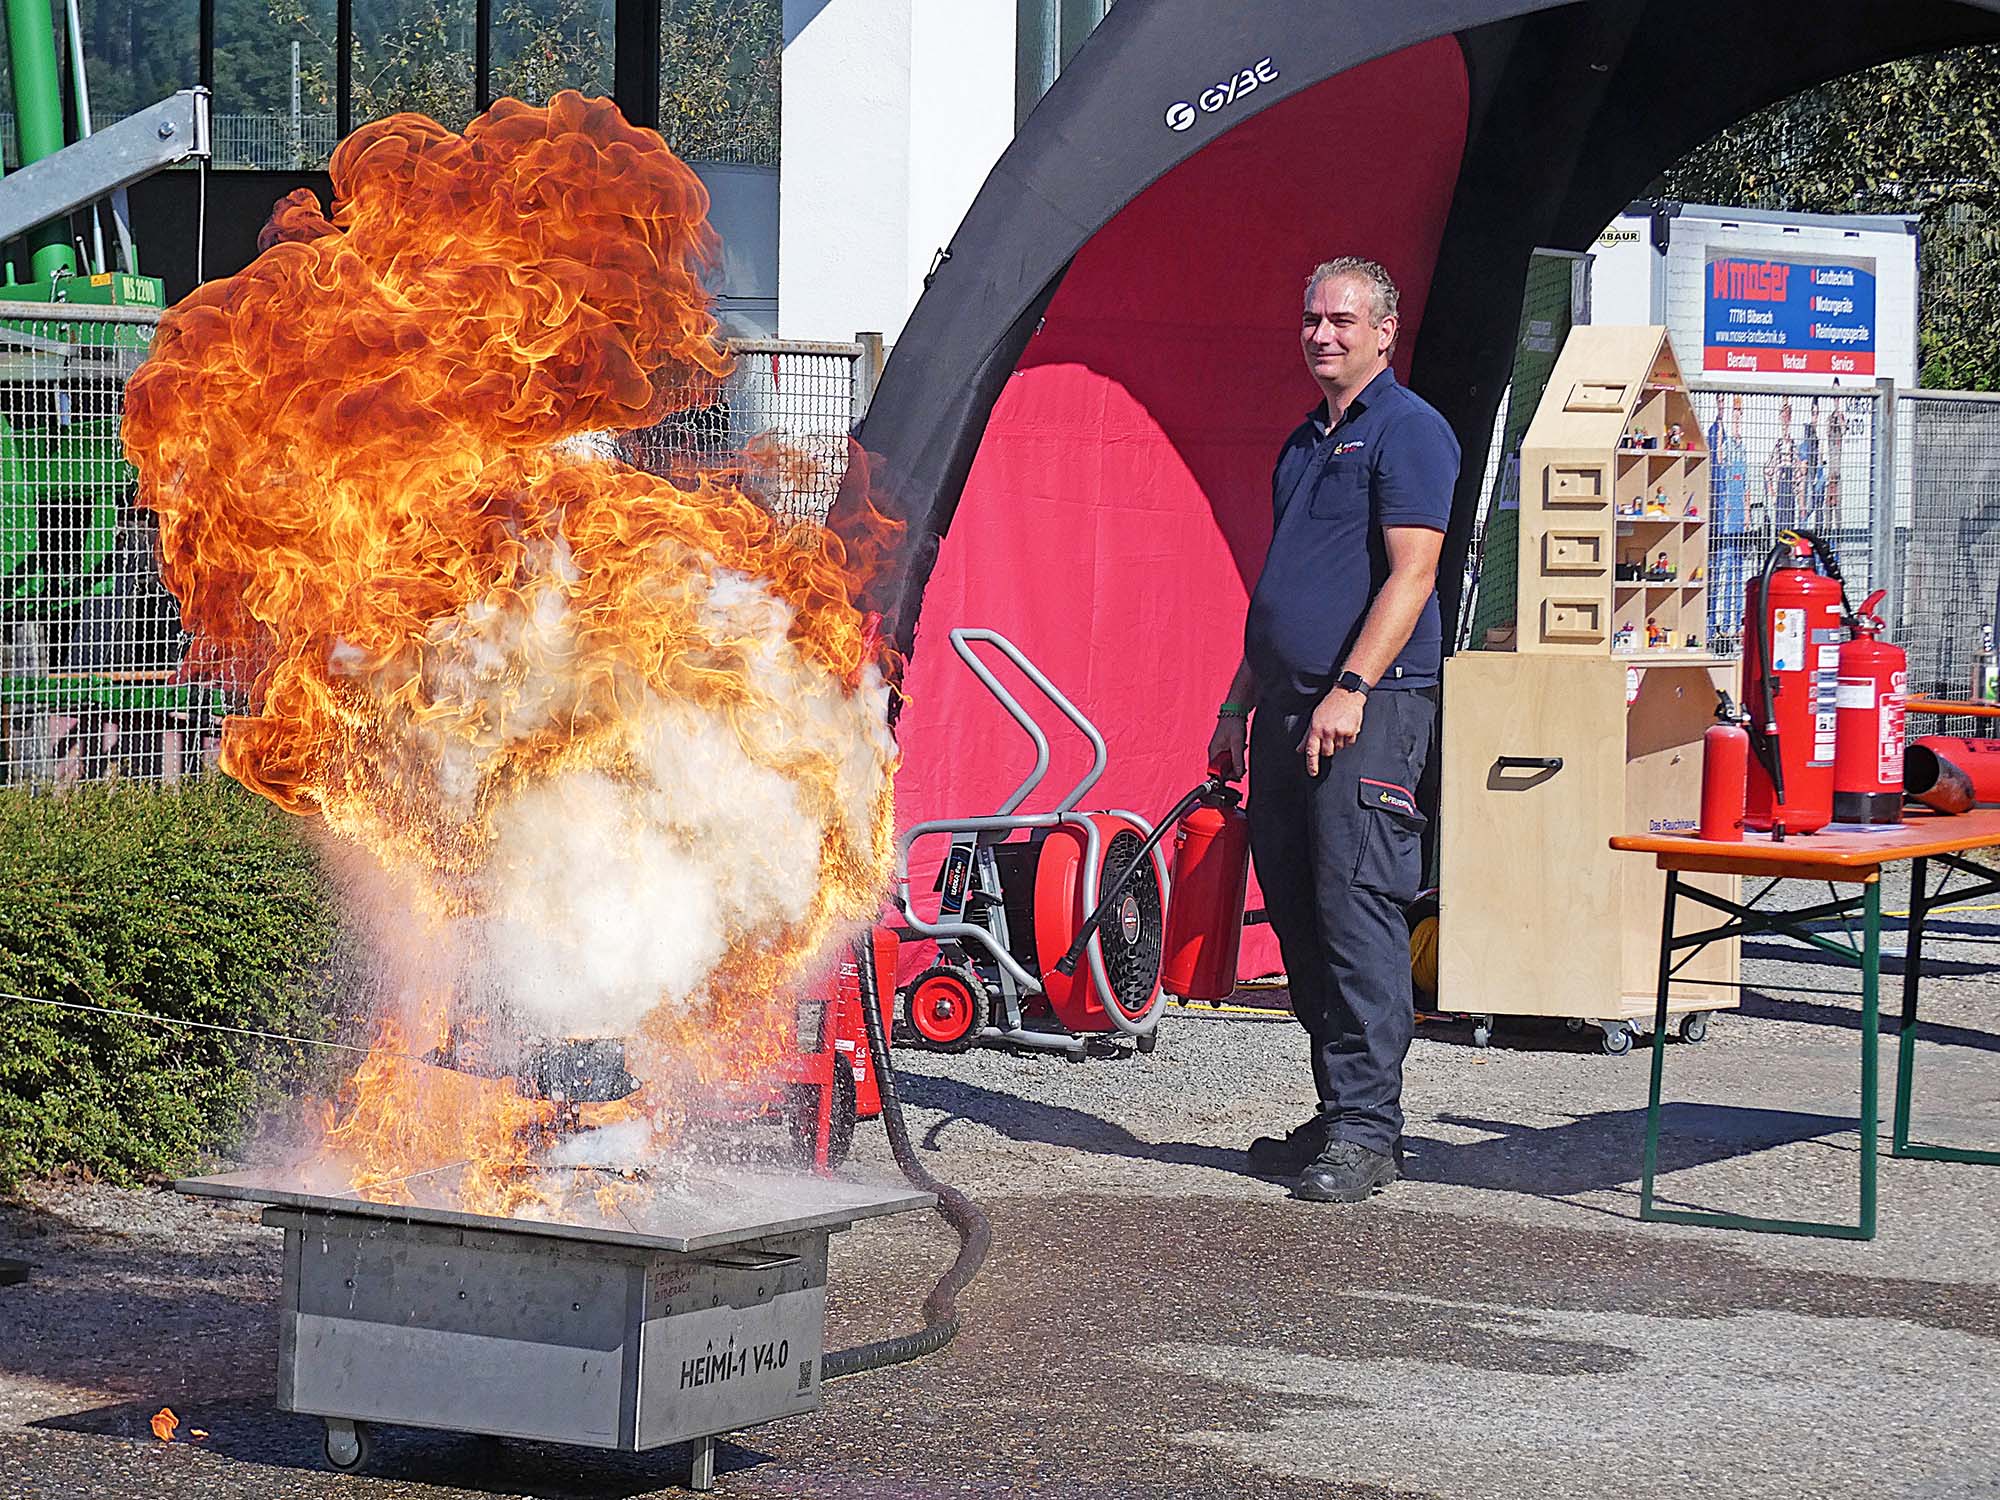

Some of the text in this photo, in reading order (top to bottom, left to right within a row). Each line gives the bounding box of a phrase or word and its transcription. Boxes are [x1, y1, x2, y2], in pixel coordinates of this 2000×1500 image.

[1199, 57, 1279, 113] GYBE
[1816, 269, 1854, 286] Landtechnik
[1816, 296, 1853, 316] Motorgeräte
[1747, 309, 1773, 325] Biberach
[1815, 323, 1869, 344] Reinigungsgeräte
[1727, 352, 1855, 371] Beratung Verkauf Service
[1662, 818, 1697, 831] Rauchhaus
[680, 1339, 789, 1390] HEIMI-1 V4.0
